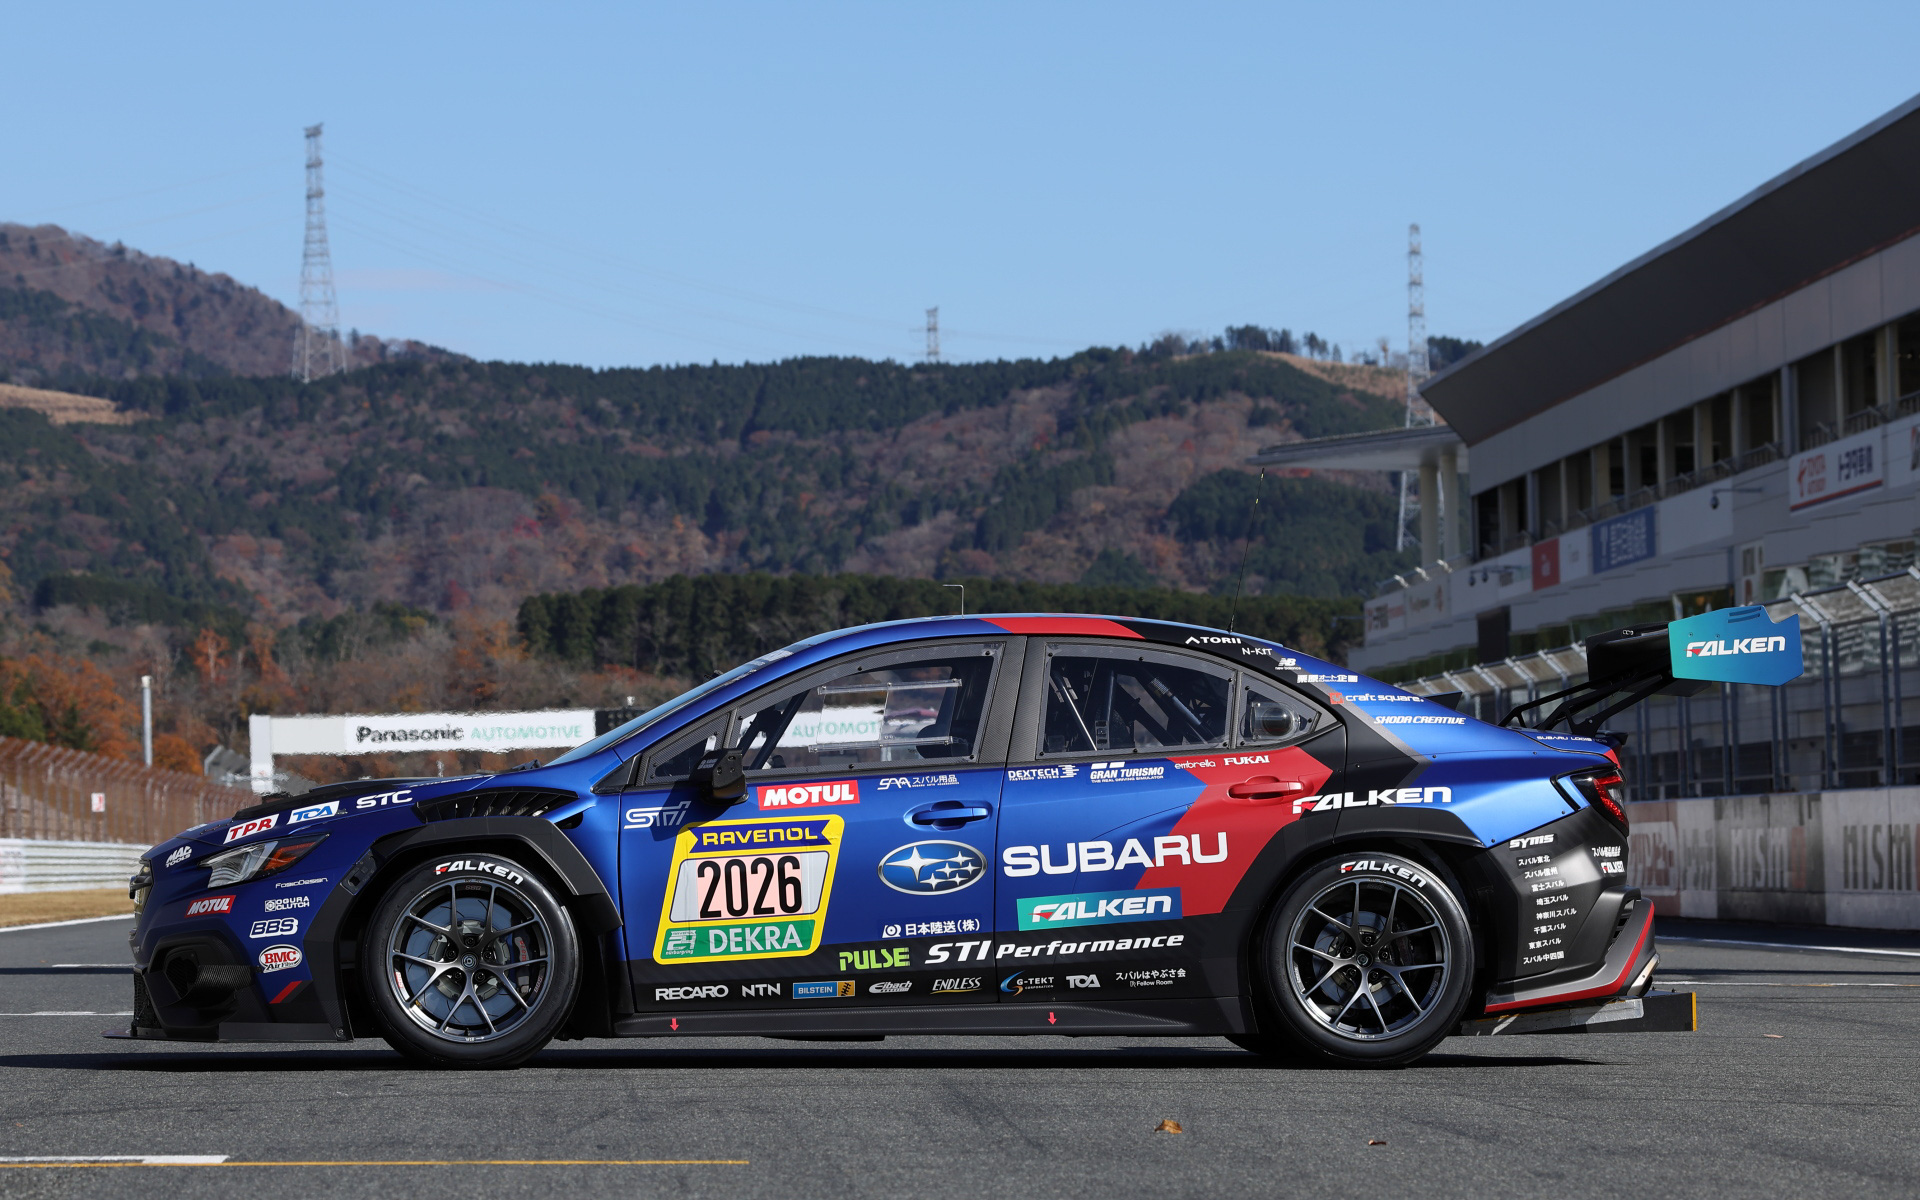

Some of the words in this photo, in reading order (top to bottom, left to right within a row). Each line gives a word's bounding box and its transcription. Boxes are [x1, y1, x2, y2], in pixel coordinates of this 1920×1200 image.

[1686, 636, 1786, 657] FALKEN
[1345, 693, 1375, 701] craft
[1374, 716, 1413, 724] SHODA
[1415, 716, 1466, 725] CREATIVE
[356, 725, 464, 743] Panasonic
[471, 724, 583, 743] AUTOMOTIVE
[1174, 759, 1216, 769] embrella
[1224, 755, 1270, 766] FUKAI
[912, 774, 957, 784] スバル用品
[1008, 768, 1059, 778] DEXTECH
[1090, 770, 1118, 780] GRAN
[1121, 767, 1164, 777] TURISMO
[356, 790, 413, 809] STC
[763, 785, 854, 806] MOTUL
[1288, 786, 1452, 814] FALKEN
[230, 818, 272, 840] TPR
[702, 827, 818, 846] RAVENOL
[1509, 834, 1555, 848] SYMS
[1002, 832, 1228, 877] SUBARU
[1518, 855, 1550, 866] スバル東北
[1843, 823, 1920, 891] nism
[434, 860, 523, 885] FALKEN
[1339, 860, 1427, 888] FALKEN
[697, 856, 802, 918] 2026
[1531, 880, 1565, 892] 富士スバル
[187, 897, 231, 915] MOTUL
[276, 895, 310, 905] OGURA
[276, 901, 310, 910] CLUTCH
[1536, 894, 1569, 906] 埼玉スバル
[1028, 895, 1172, 922] FALKEN
[1536, 907, 1577, 920] 神奈川スバル
[249, 917, 298, 938] BBS
[904, 919, 980, 937] 日本陸送（株）
[1533, 923, 1567, 935] 千葉スバル
[708, 923, 803, 954] DEKRA
[1528, 938, 1562, 950] 東京スバル
[264, 950, 297, 964] BMC
[925, 940, 992, 965] STI
[996, 934, 1184, 959] Performance
[839, 947, 911, 971] PULSE
[1523, 950, 1565, 965] スバル中四国
[266, 961, 281, 970] Air
[1016, 976, 1055, 986] G-TEKT
[1065, 973, 1101, 989] TOA
[1115, 967, 1187, 981] スバルはやぶさ会
[741, 983, 781, 998] NTN
[798, 985, 833, 995] BILSTEIN
[868, 980, 913, 994] Eibach
[931, 976, 982, 991] ENDLESS
[655, 984, 729, 1001] RECARO
